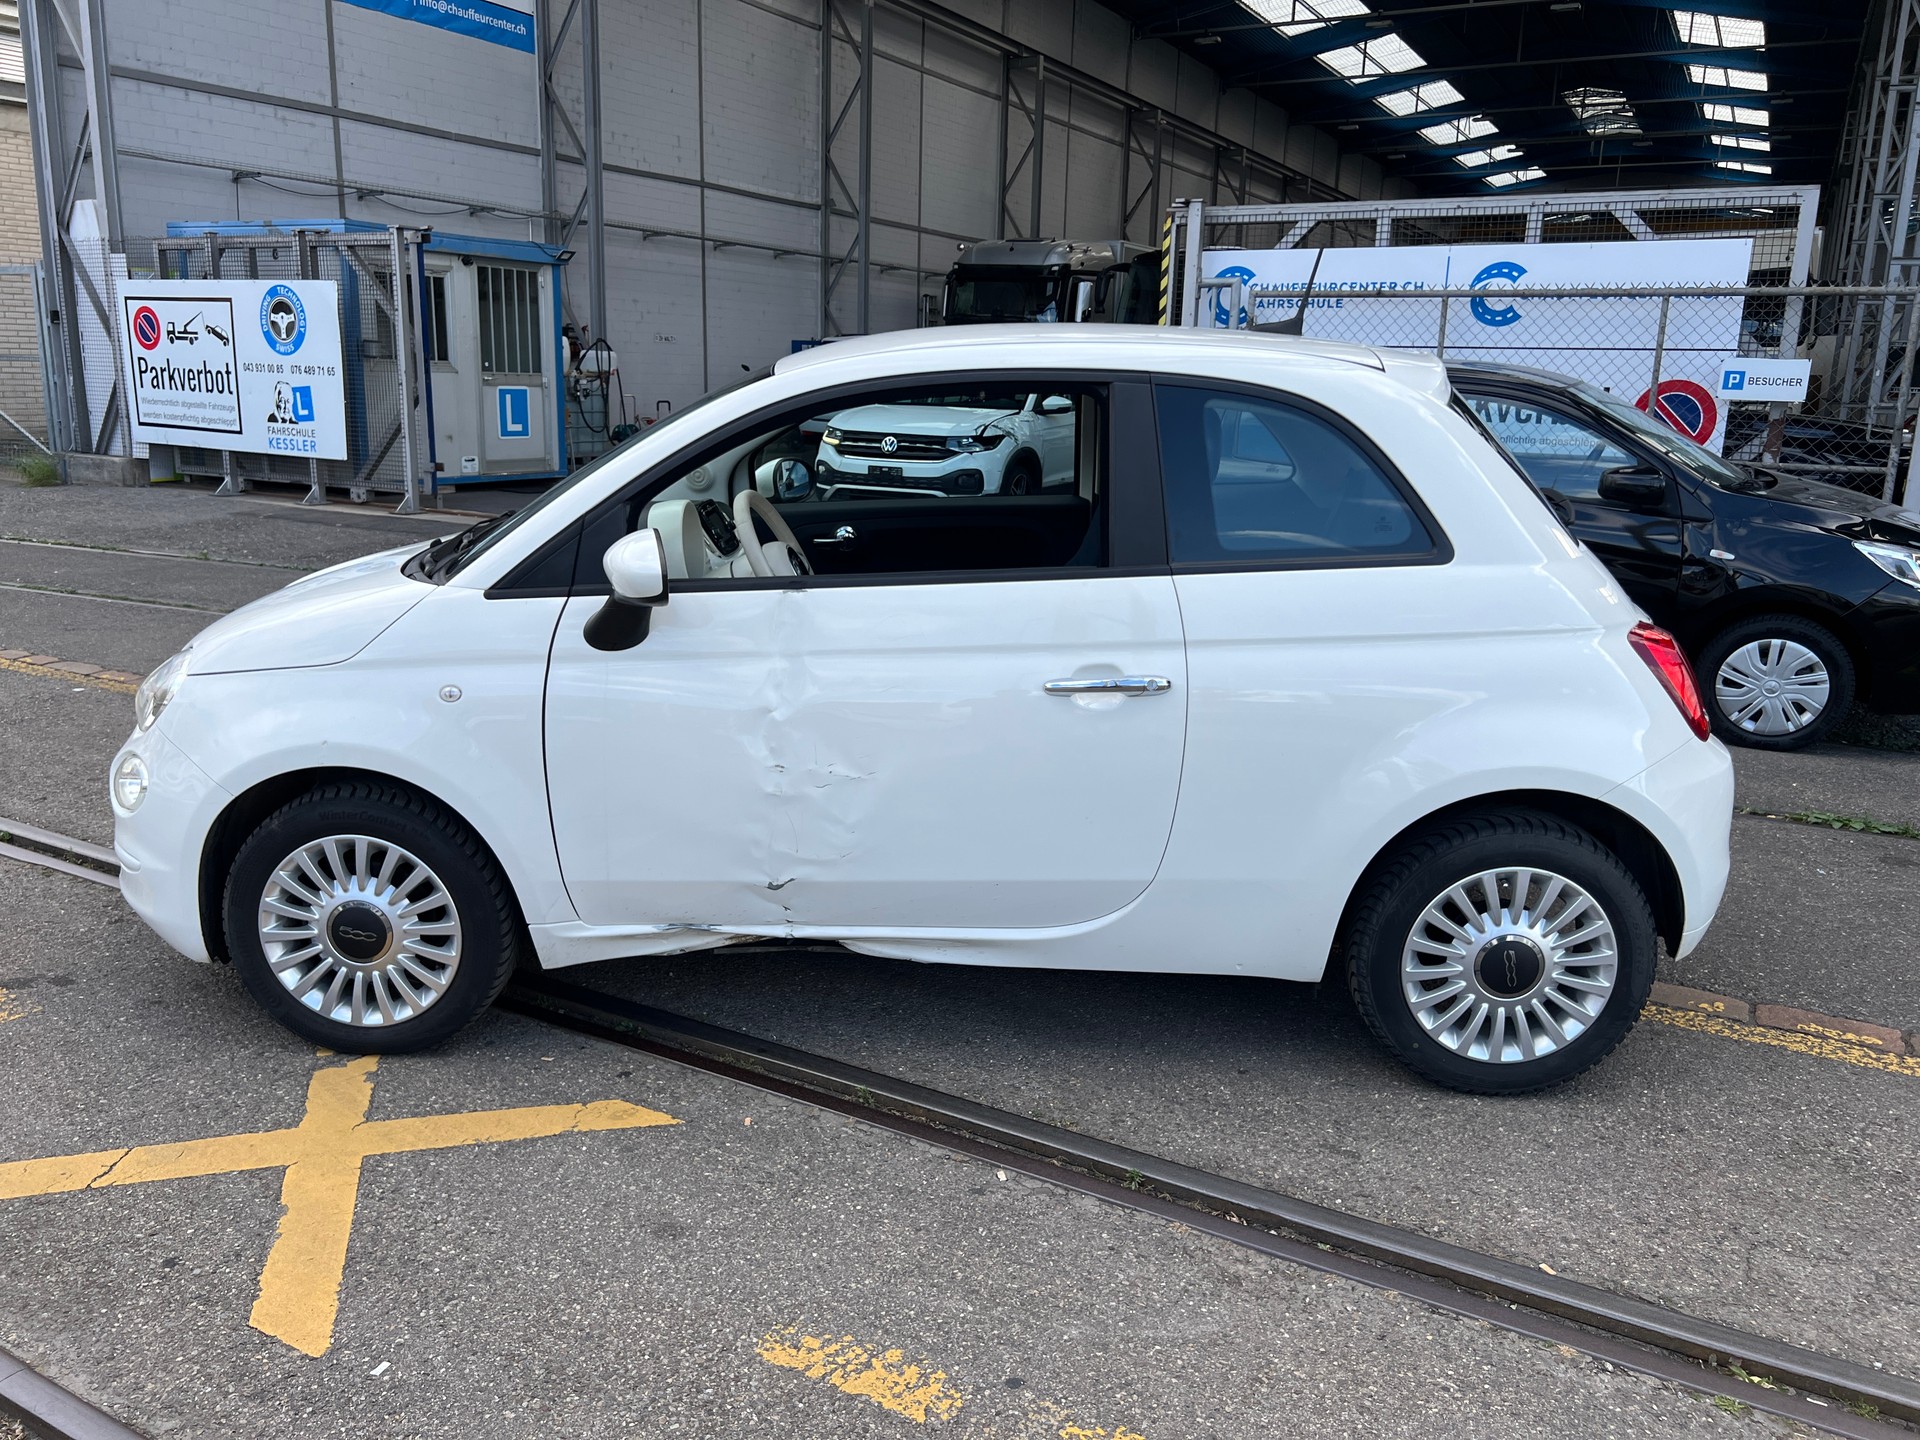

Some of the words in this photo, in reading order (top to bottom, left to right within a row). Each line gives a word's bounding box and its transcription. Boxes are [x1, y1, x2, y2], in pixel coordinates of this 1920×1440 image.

[277, 286, 305, 333] TECHNOLOGY
[1256, 298, 1343, 308] AHRSCHULE
[261, 294, 271, 332] DRIVING
[276, 343, 294, 353] SWISS
[137, 356, 233, 395] Parkverbot
[243, 362, 254, 372] 043
[255, 363, 266, 373] 931
[267, 363, 275, 373] 00
[276, 364, 284, 374] 85
[290, 365, 302, 374] 076
[304, 365, 315, 375] 489
[317, 366, 325, 375] 71
[327, 366, 336, 376] 65
[1747, 376, 1803, 387] BESUCHER
[505, 394, 523, 431] L
[267, 425, 316, 438] FAHRSCHULE
[268, 437, 317, 452] KESSLER
